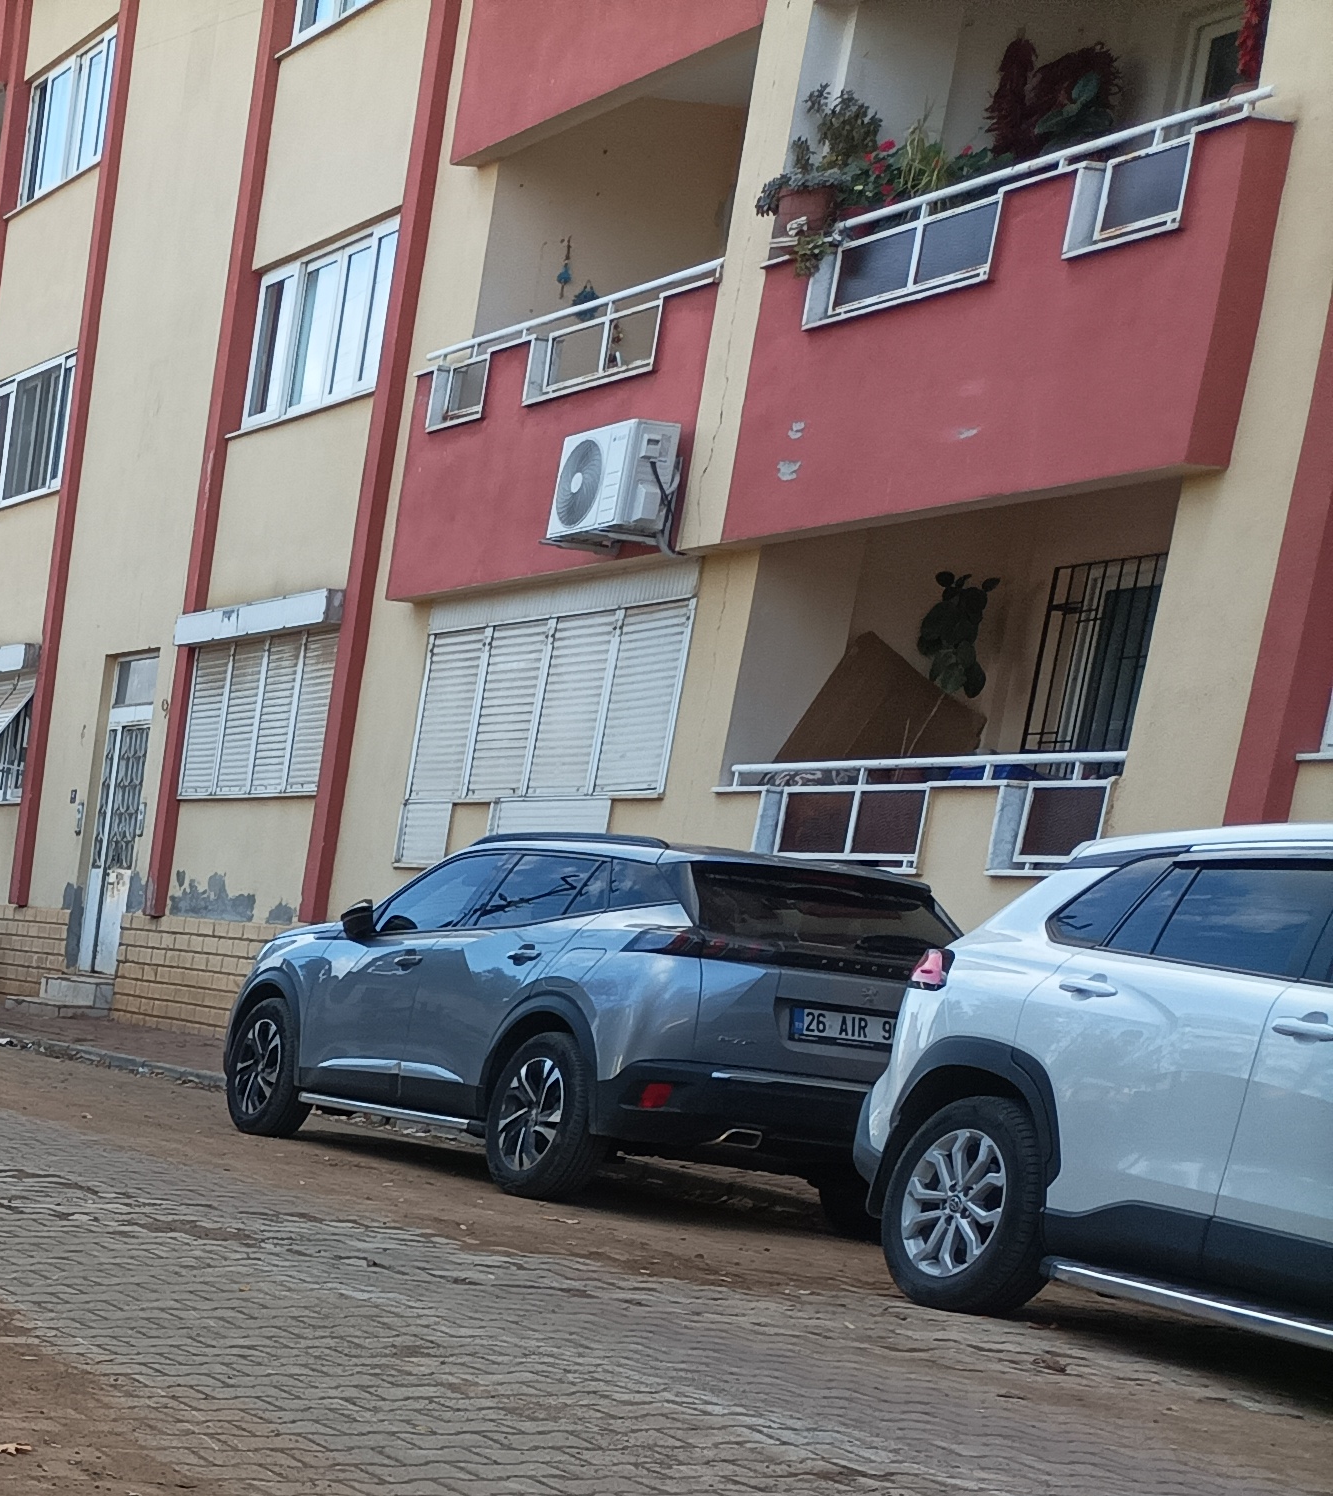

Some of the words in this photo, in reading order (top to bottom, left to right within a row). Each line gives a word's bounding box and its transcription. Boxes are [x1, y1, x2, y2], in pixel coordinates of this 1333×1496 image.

[805, 1011, 827, 1034] 26
[838, 1015, 869, 1039] AIR
[882, 1020, 898, 1041] 9
